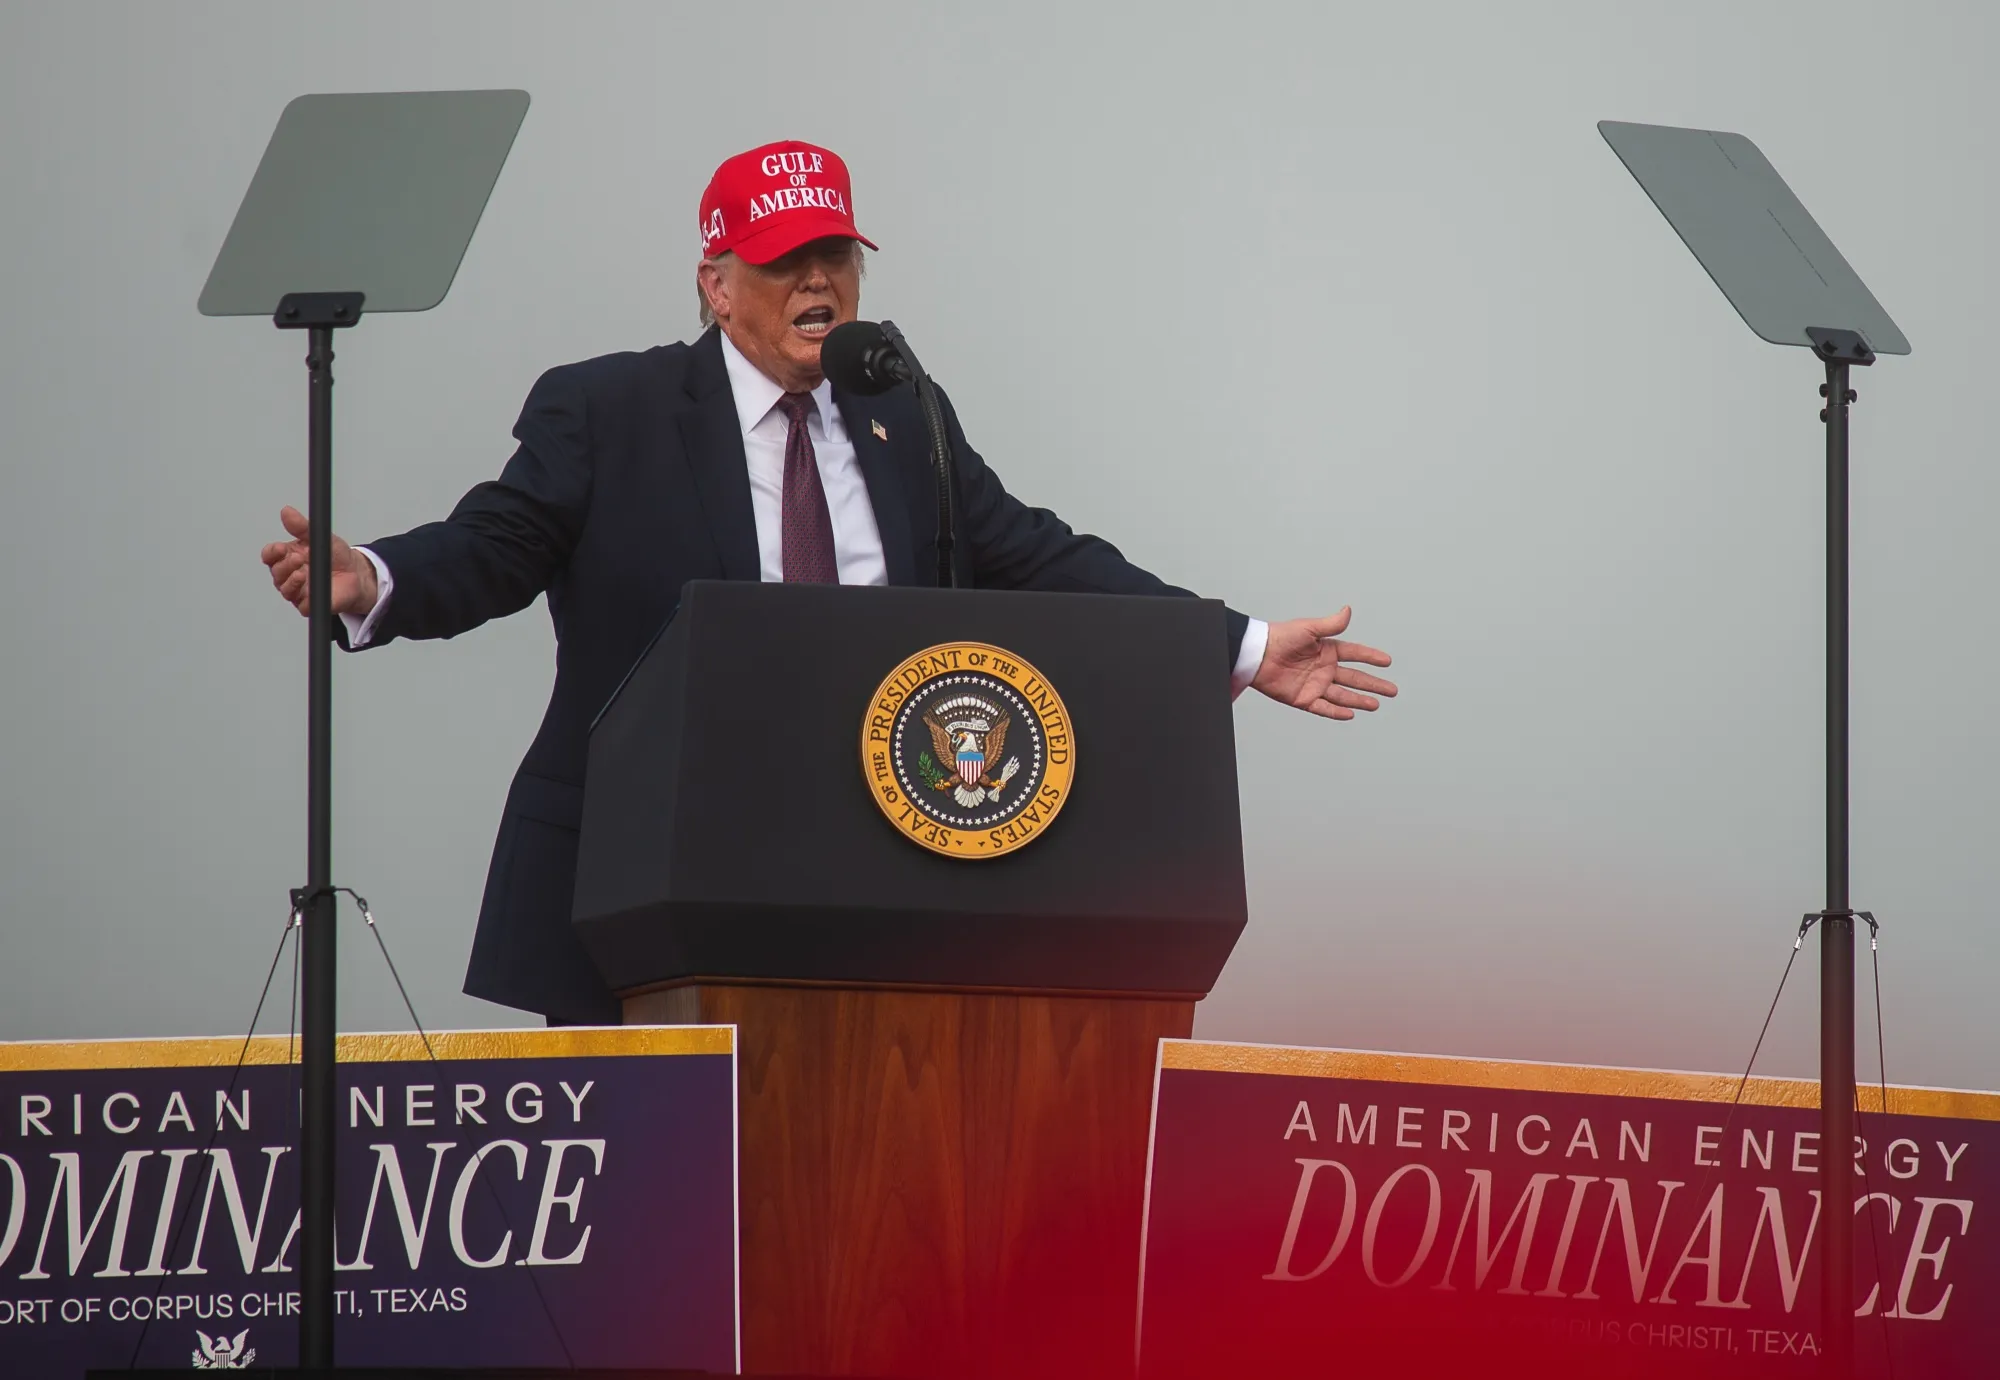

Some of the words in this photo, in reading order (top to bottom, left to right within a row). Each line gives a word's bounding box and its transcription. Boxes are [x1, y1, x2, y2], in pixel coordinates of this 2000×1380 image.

[761, 152, 823, 177] GULF
[790, 174, 807, 187] OF
[750, 187, 848, 222] AMERICA
[968, 652, 989, 666] OF
[992, 657, 1019, 679] THE
[870, 650, 962, 744] PRESIDENT
[1023, 677, 1068, 765] UNITED
[873, 751, 890, 781] THE
[882, 785, 899, 804] OF
[897, 800, 952, 847] SEAL
[989, 784, 1060, 849] STATES
[300, 1081, 595, 1129] NERGY
[1284, 1100, 1652, 1162] AMERICAN
[61, 1298, 101, 1323] OF
[109, 1294, 234, 1321] CORPUS
[240, 1290, 363, 1318] CHRTI,
[370, 1287, 467, 1314] TEXAS
[1628, 1322, 1738, 1355] CHRISTI,
[1746, 1329, 1822, 1356] TEXA
